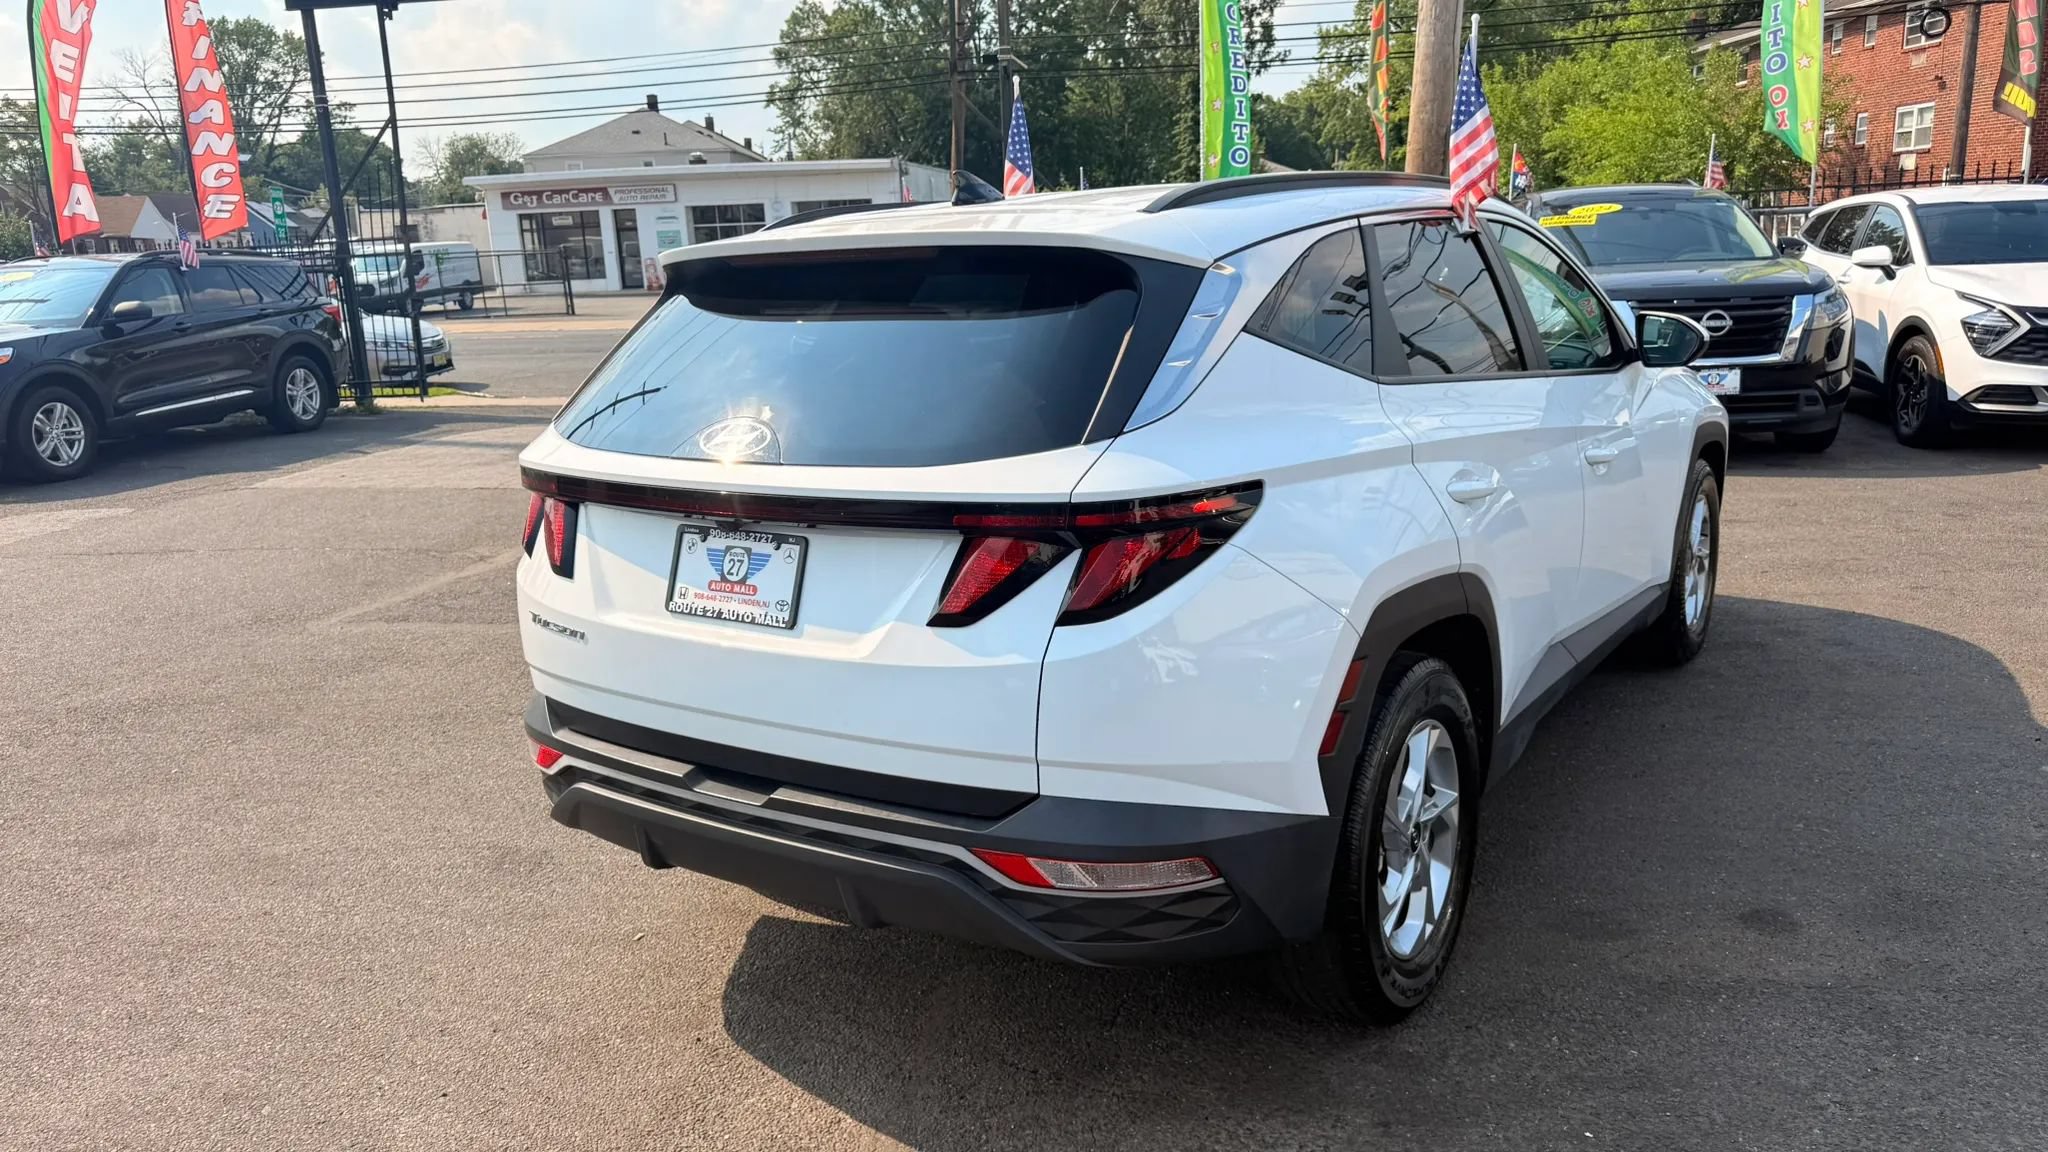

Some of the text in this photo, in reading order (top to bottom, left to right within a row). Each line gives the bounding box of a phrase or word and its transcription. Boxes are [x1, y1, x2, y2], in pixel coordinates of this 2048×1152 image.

[1226, 3, 1249, 168] CREDITO
[542, 190, 603, 204] CarCare
[614, 186, 670, 195] PROFESSIONAL
[709, 528, 773, 543] 908-648-2727
[726, 558, 745, 577] 27
[710, 582, 755, 595] AUTO MALL
[668, 601, 787, 627] ROUTE 27 AUTO MALL
